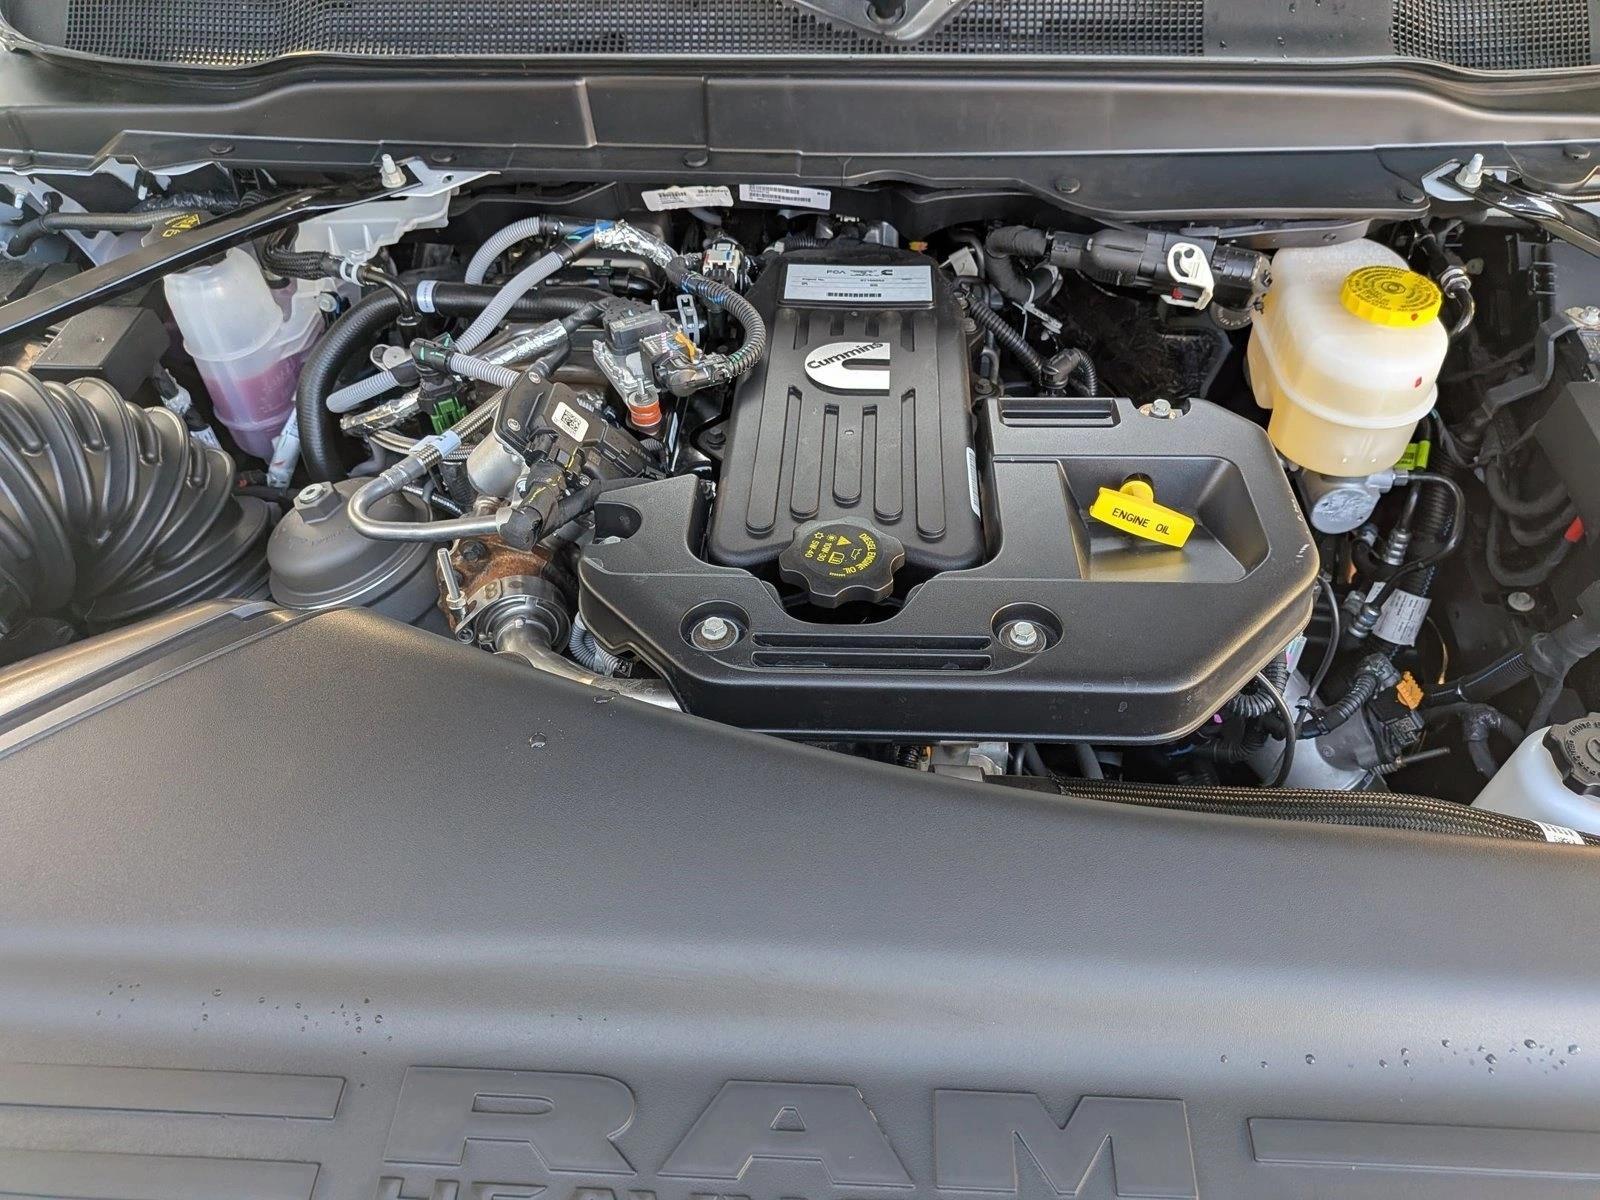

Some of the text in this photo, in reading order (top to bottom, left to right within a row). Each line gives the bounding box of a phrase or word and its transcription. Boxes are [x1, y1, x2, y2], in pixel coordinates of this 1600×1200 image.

[807, 342, 884, 369] Cummins
[1112, 507, 1170, 535] ENGINE OIL
[843, 533, 876, 574] DIESEL ENGINE OIL
[382, 1066, 1200, 1200] RAM
